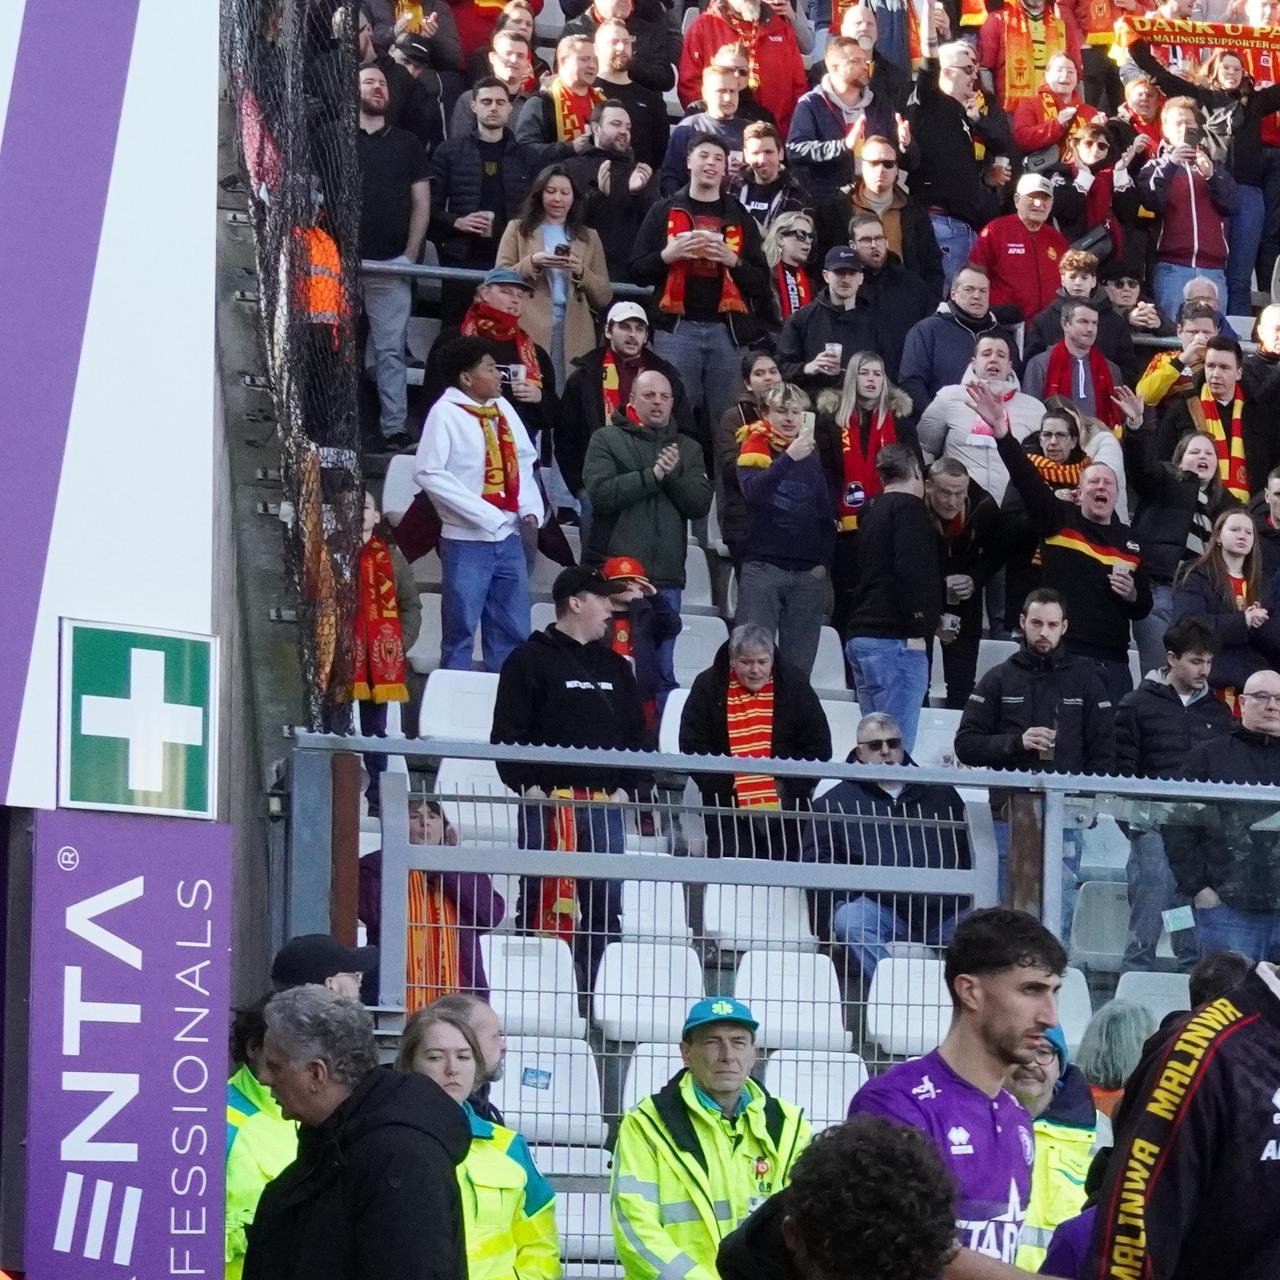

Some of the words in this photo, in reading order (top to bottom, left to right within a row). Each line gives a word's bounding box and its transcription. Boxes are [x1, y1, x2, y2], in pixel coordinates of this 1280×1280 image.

[1134, 17, 1214, 35] DANK
[1224, 23, 1243, 36] U
[1153, 34, 1206, 45] MALINOIS
[1207, 37, 1269, 50] SUPPORTER
[1146, 997, 1244, 1121] MALINWA
[954, 1219, 1019, 1266] TAR
